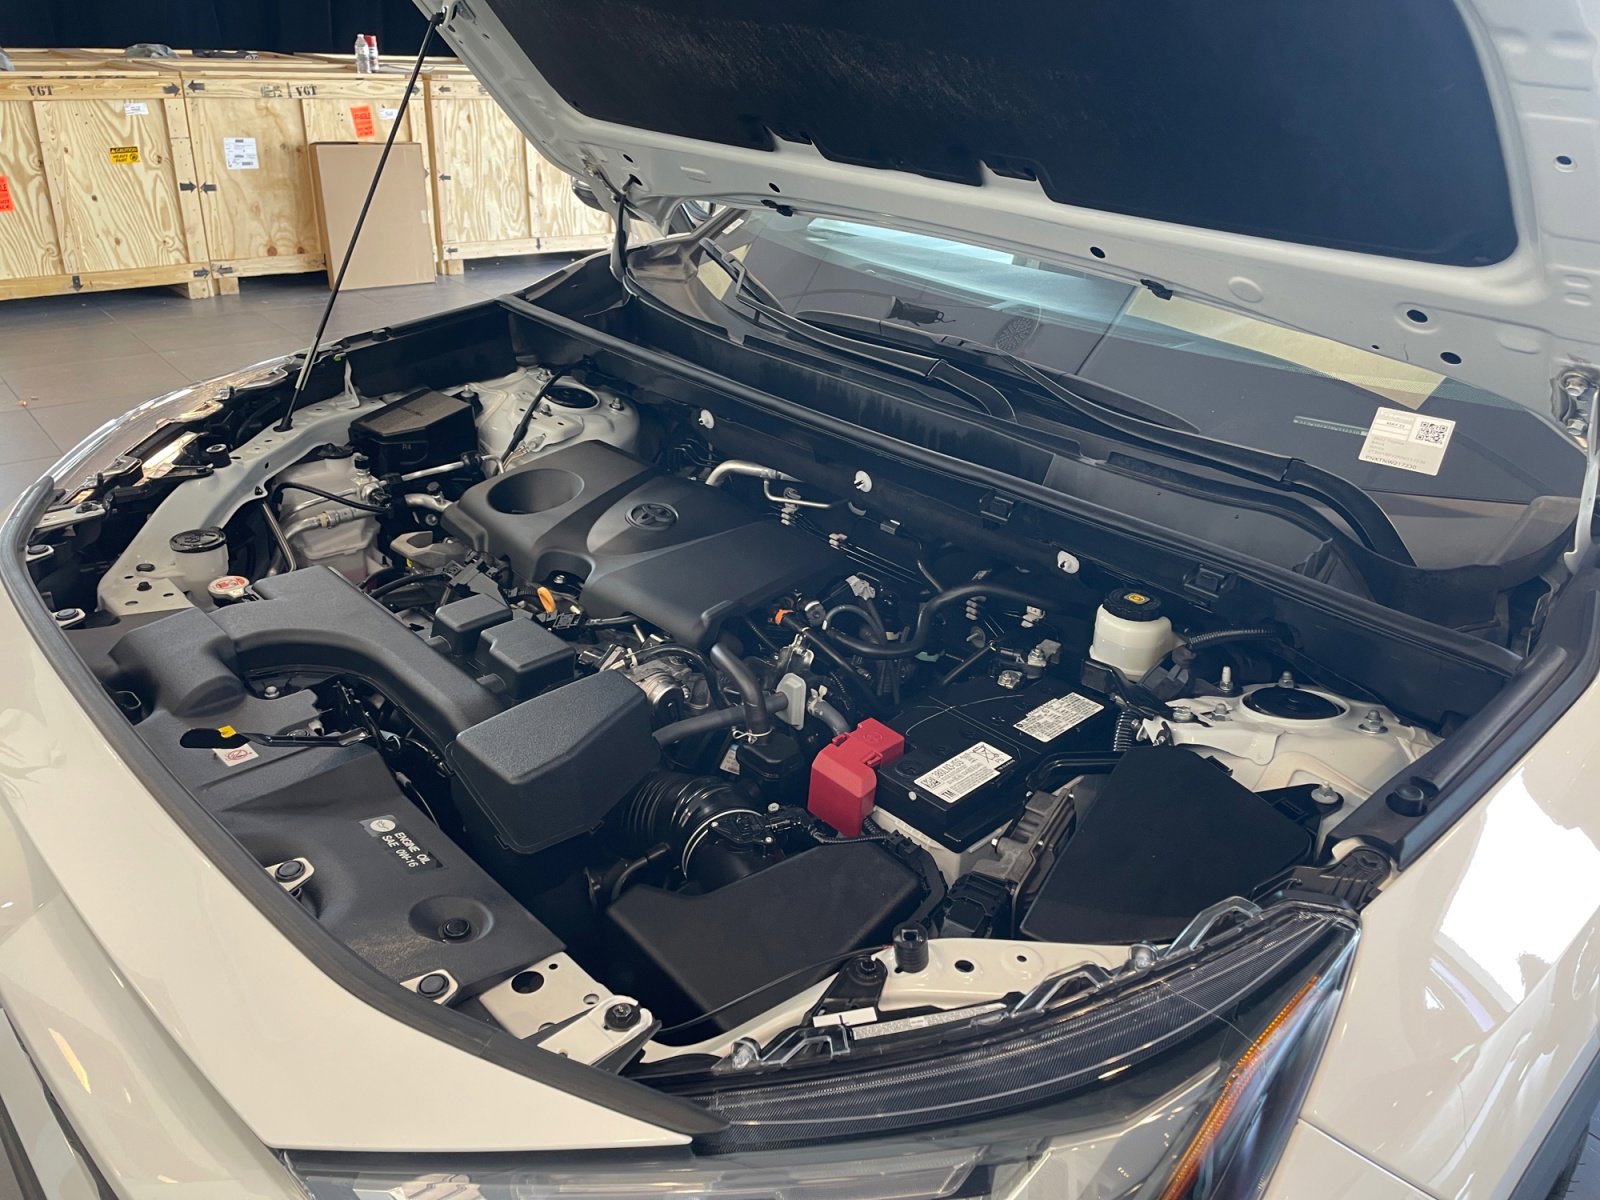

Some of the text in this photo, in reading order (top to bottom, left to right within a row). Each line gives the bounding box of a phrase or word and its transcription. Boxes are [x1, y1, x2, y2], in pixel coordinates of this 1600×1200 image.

[27, 85, 54, 96] VGT
[295, 85, 318, 96] VGT
[382, 835, 419, 868] SAE 0W-16
[394, 832, 431, 865] ENGINE OIL
